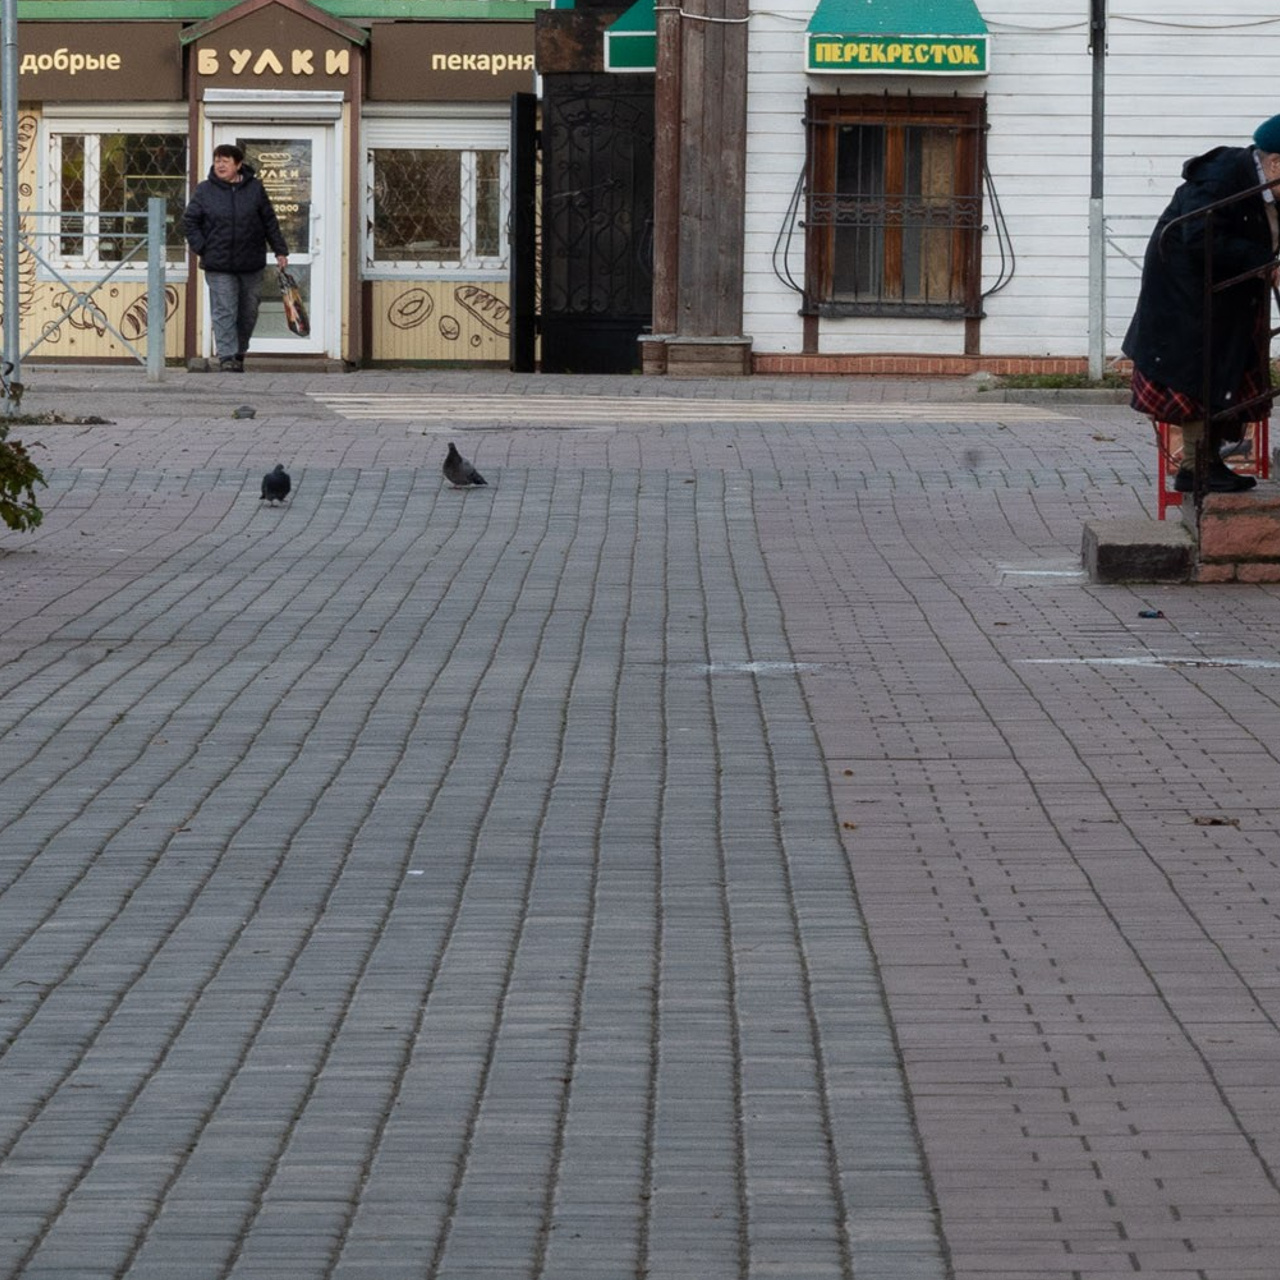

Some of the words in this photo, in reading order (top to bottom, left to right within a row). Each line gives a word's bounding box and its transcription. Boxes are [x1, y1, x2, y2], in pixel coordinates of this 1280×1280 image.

[19, 48, 122, 75] добрые
[197, 48, 350, 75] БУЛКИ
[431, 53, 536, 75] пекарня
[815, 43, 980, 65] ПЕРЕКРЕСТОК
[253, 169, 299, 179] УЛКИ
